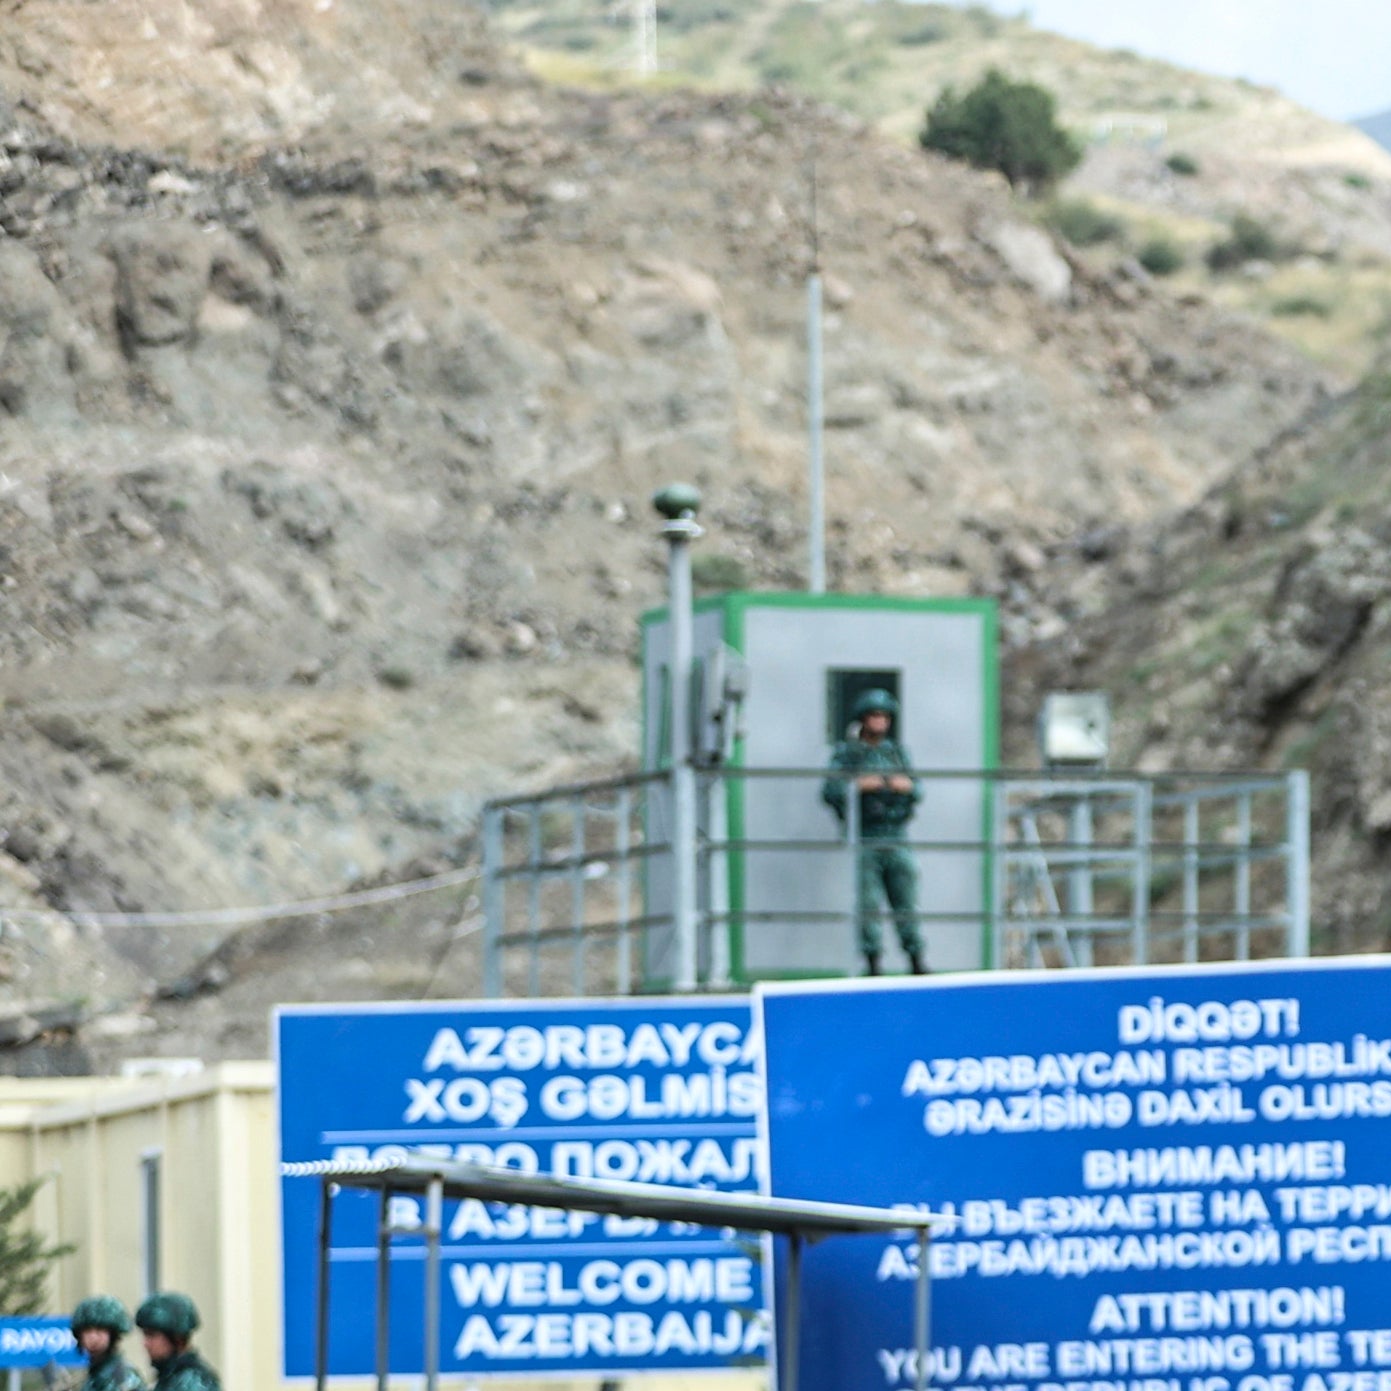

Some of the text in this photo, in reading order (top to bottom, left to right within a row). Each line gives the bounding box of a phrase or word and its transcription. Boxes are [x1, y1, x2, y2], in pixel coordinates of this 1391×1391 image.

[1117, 996, 1300, 1045] DİQQƏT!
[901, 1050, 1167, 1097] AZƏRBAYCAN
[403, 1076, 529, 1130] XOŞ
[923, 1086, 1133, 1136] ƏRAZİSİNƏ
[1136, 1080, 1257, 1127] DAXİL
[1083, 1140, 1346, 1190] ВНИМАНИЕ!
[961, 1191, 1204, 1237] ВЪЕЗЖАЕТЕ
[1210, 1189, 1270, 1226] НА
[449, 1257, 754, 1308] WELCOME
[1089, 1285, 1346, 1334] ATTENTION!
[877, 1346, 962, 1385] YOU
[967, 1342, 1050, 1381] ARE
[1056, 1334, 1255, 1378] ENTERING
[1259, 1331, 1341, 1369] THE
